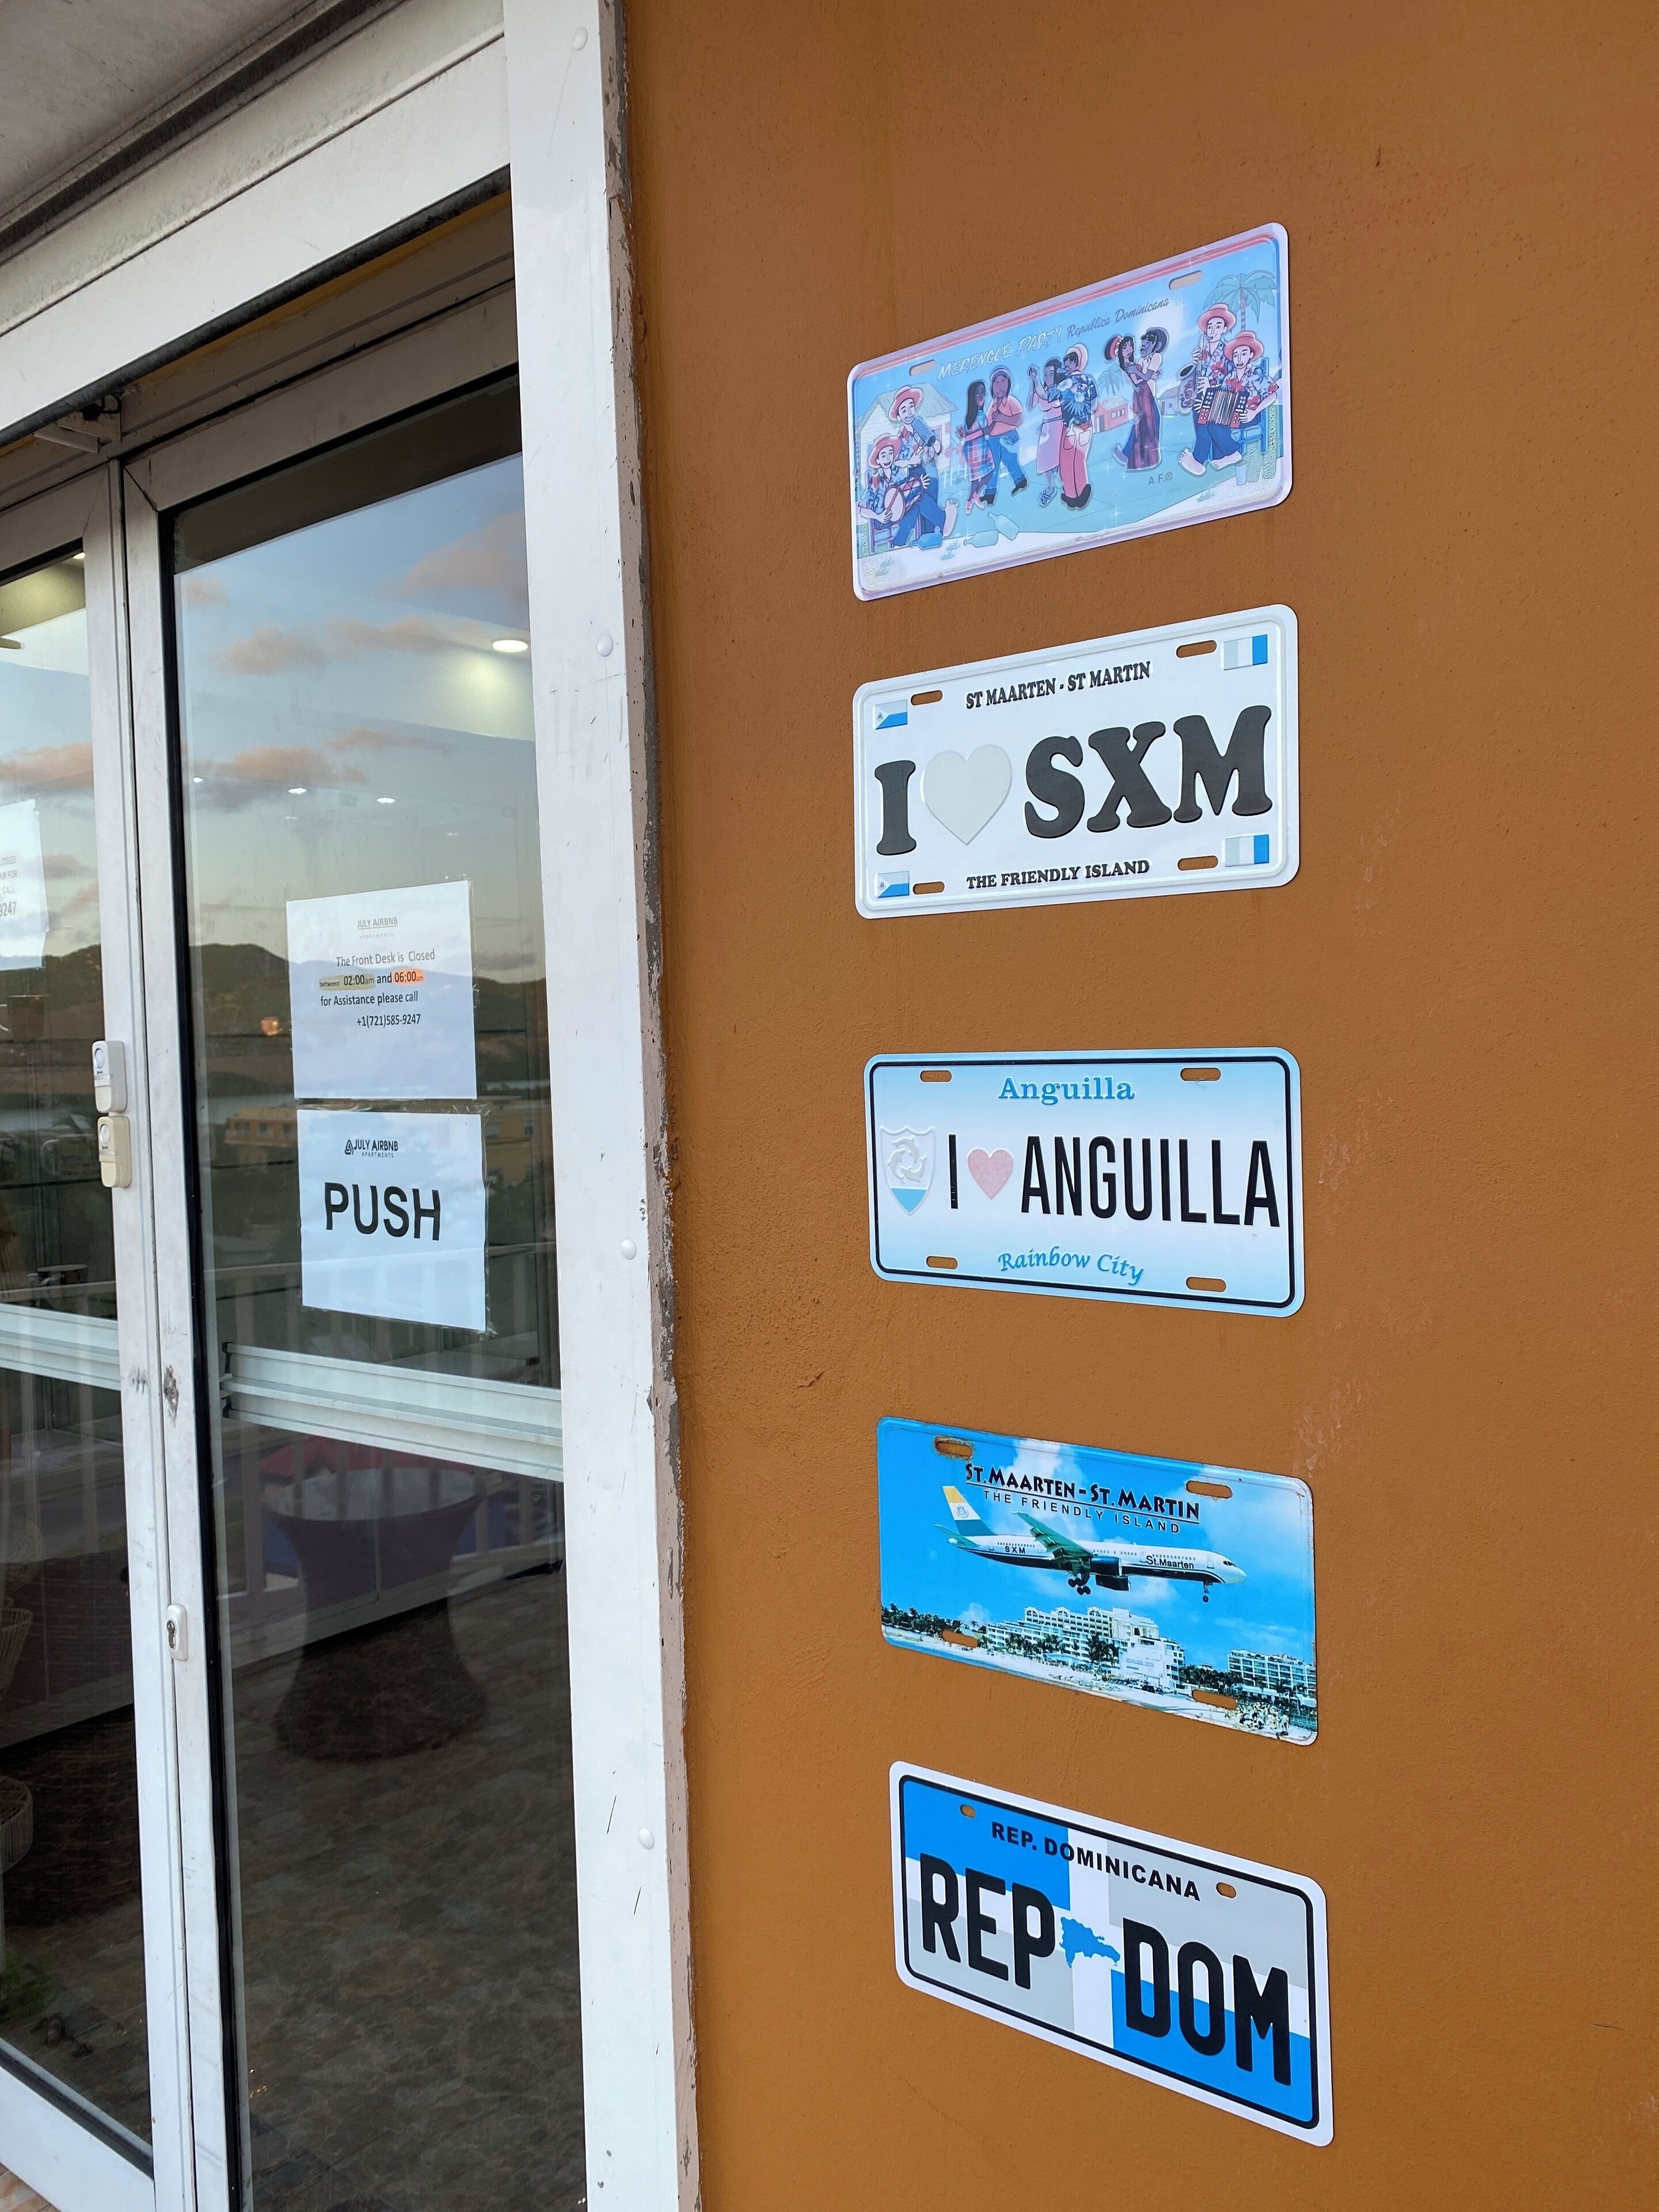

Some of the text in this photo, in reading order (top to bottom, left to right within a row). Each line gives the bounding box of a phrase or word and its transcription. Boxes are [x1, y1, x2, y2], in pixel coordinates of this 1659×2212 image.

[937, 297, 1170, 381] MERENGUE PARTY Republica Dominicana
[966, 691, 983, 709] ST
[986, 678, 1056, 706] MAARTEN
[1067, 673, 1086, 691] ST
[1090, 661, 1151, 688] MARTIN
[874, 705, 1272, 855] I SXM
[967, 859, 1150, 889] THE FRIENDLY ISLAND
[357, 916, 398, 929] JULY AIRBNB
[336, 948, 435, 967] The Front Desk is Closed
[343, 974, 374, 986] 02:00am
[377, 972, 392, 984] and
[394, 971, 424, 983] 06:00am
[320, 990, 418, 1006] for Assistance please call
[357, 1013, 421, 1028] +1(721)585-9247
[998, 1077, 1135, 1105] Anguilla
[354, 1139, 399, 1152] JULY AIRBNB
[948, 1134, 1280, 1228] I ANGUILLA
[324, 1182, 441, 1241] PUSH
[998, 1245, 1144, 1286] Rainbow City
[984, 1490, 1180, 1534] THE FRIENDLY ISLAND
[1005, 1546, 1026, 1554] SXM
[992, 1821, 1200, 1902] REP. DOMINICANA
[919, 1853, 1292, 2086] REP DOM
